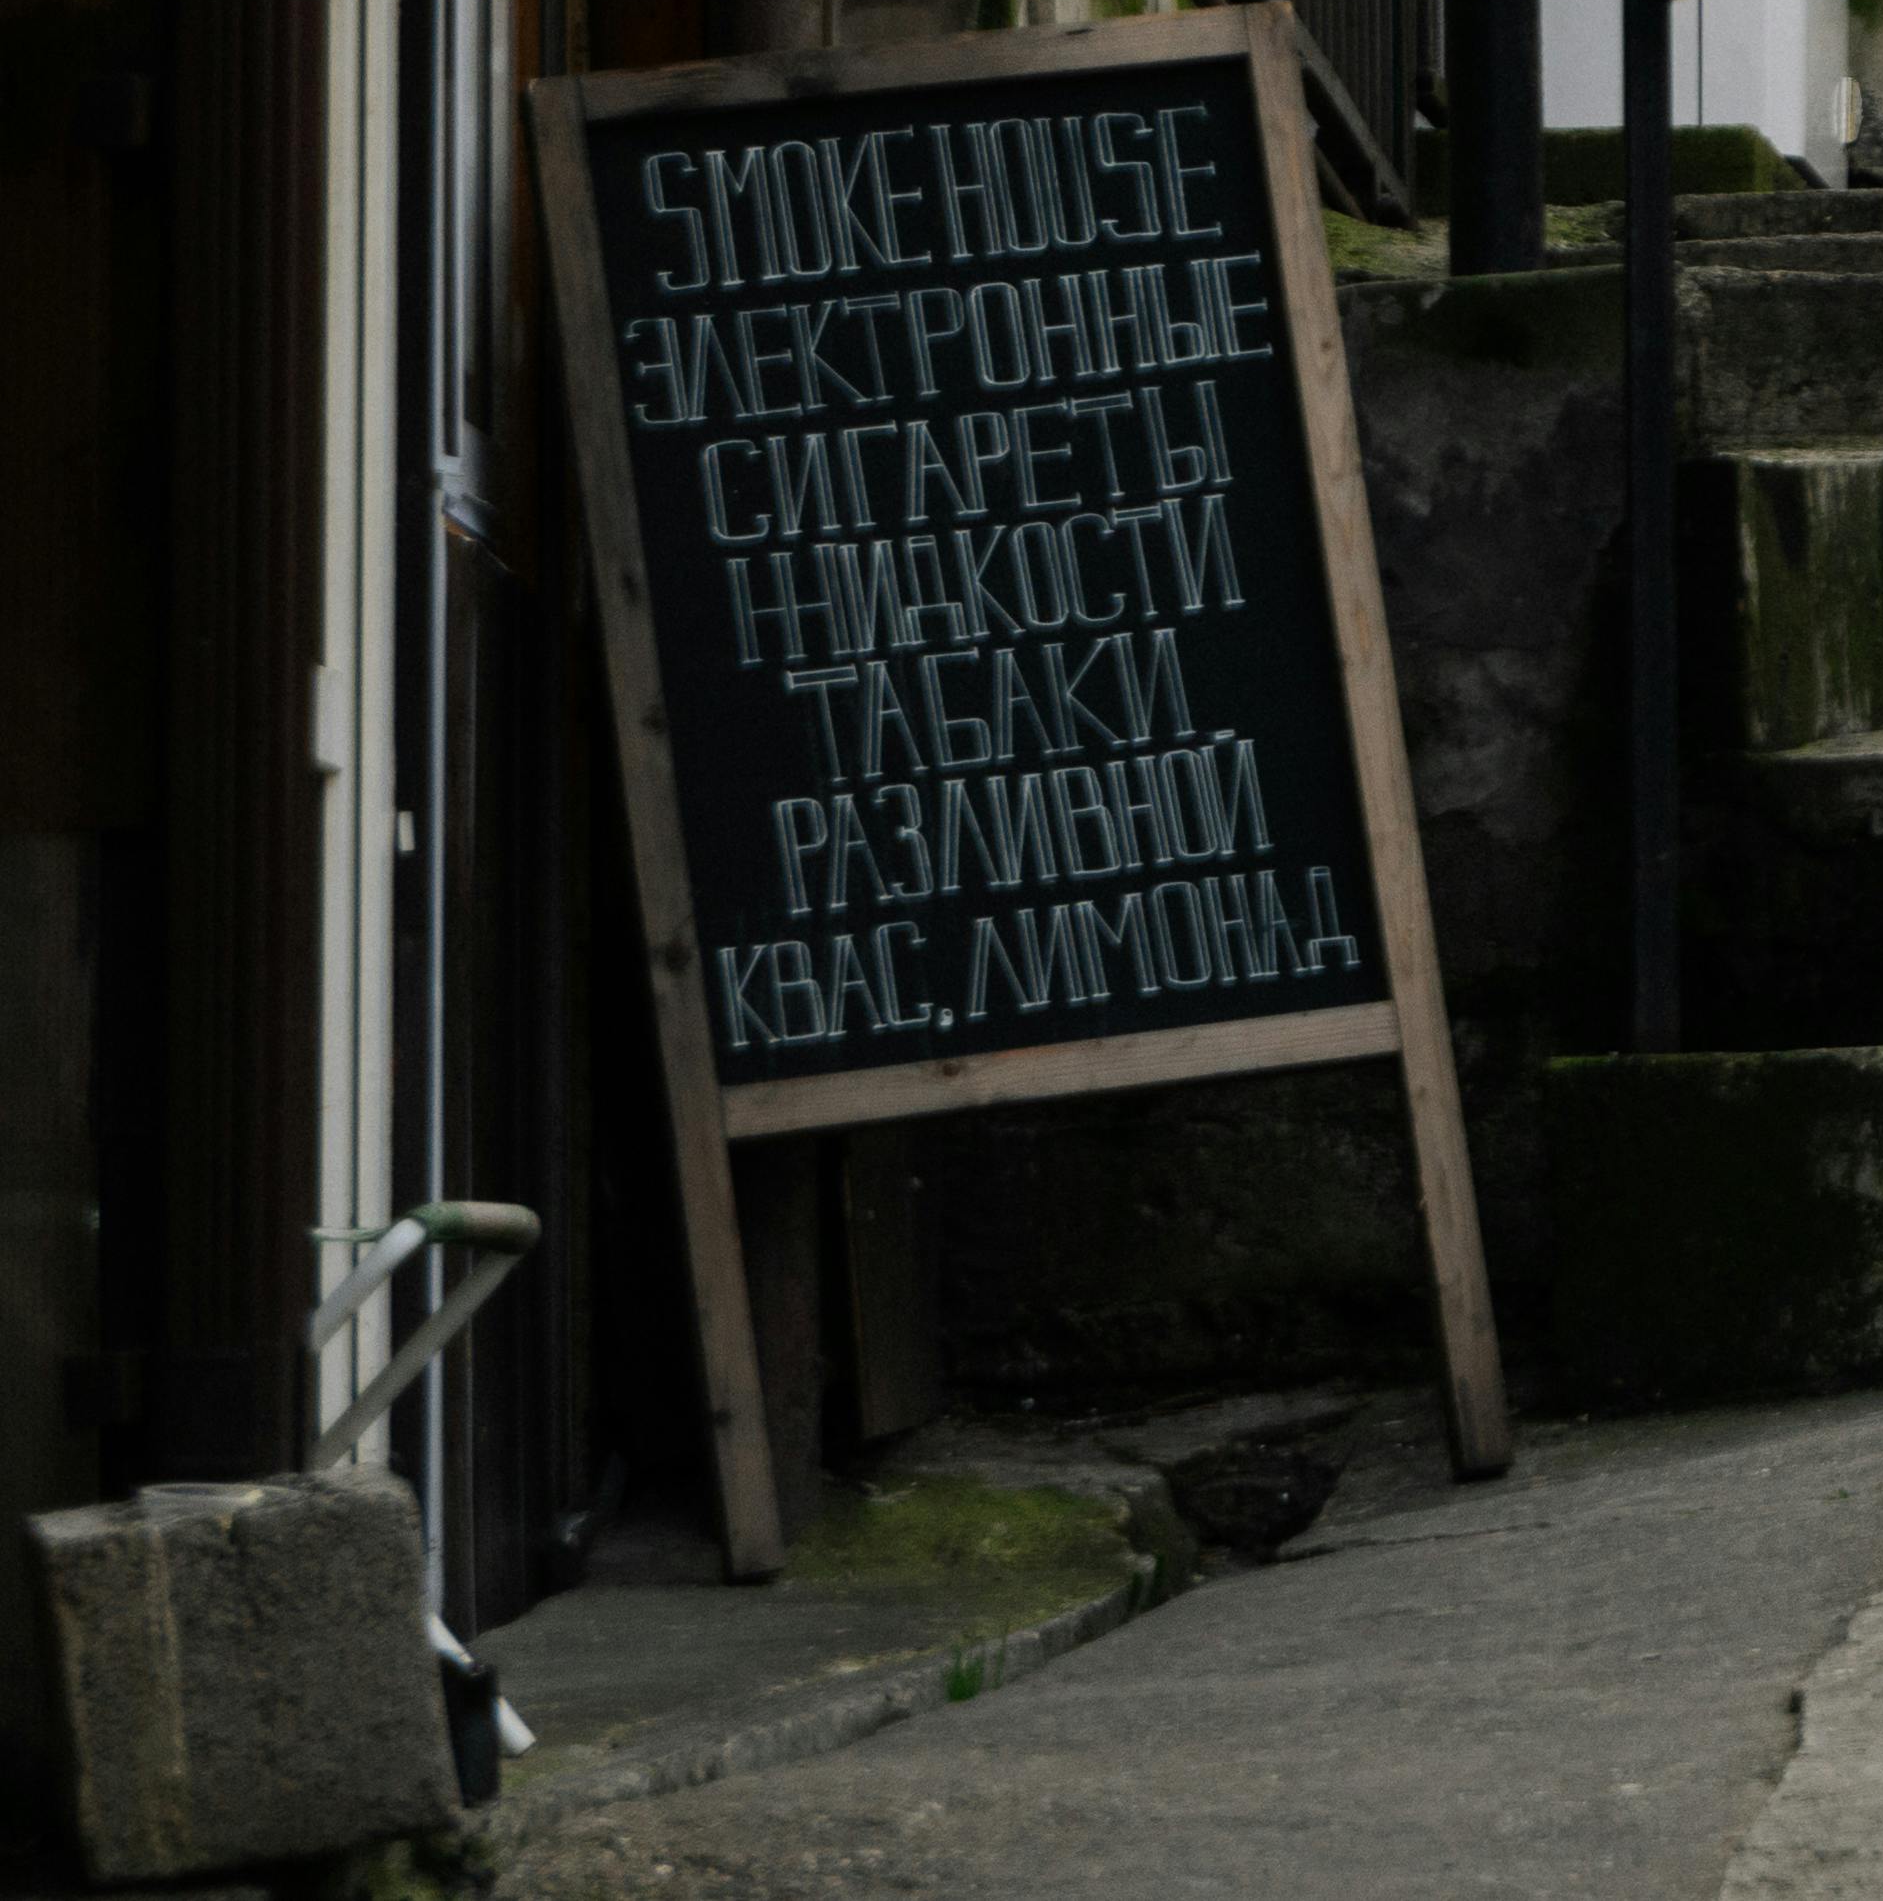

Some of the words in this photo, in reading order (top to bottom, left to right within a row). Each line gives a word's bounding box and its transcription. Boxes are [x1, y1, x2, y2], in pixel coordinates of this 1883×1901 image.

[625, 250, 1273, 426] ЭЛЕКТРОННЫЕ
[702, 379, 1234, 541] СИГАРЕТЫ
[726, 493, 1246, 665] ЖИДКОСТИ
[784, 628, 1197, 783] ТАБАКИ
[772, 729, 1275, 914] РАЗЛИВНОЙ
[717, 920, 954, 1048] КВАС,
[965, 864, 1362, 1019] ЛИМОНАД
